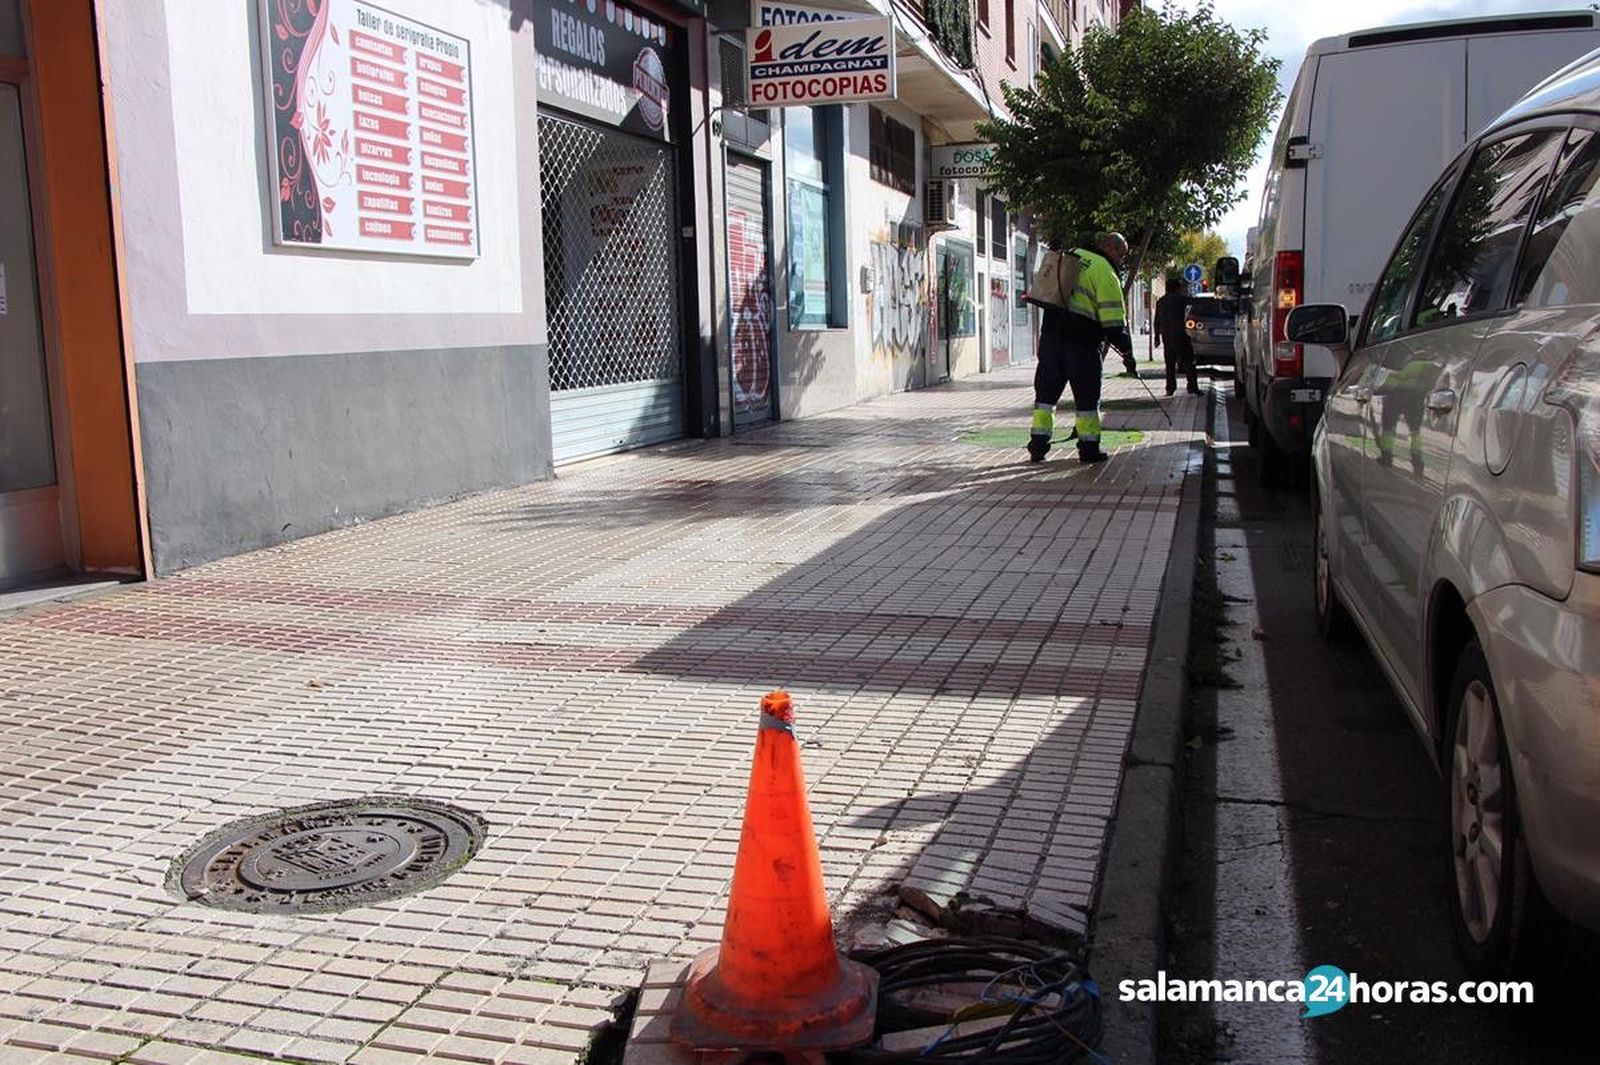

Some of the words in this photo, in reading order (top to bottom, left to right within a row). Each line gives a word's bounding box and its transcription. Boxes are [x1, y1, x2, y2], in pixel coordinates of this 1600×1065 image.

[357, 9, 381, 32] Taller
[383, 20, 394, 36] de
[551, 7, 605, 66] REGALOS
[754, 58, 885, 77] CHAMPAGNAT
[751, 74, 887, 102] FOTOCOPIAS
